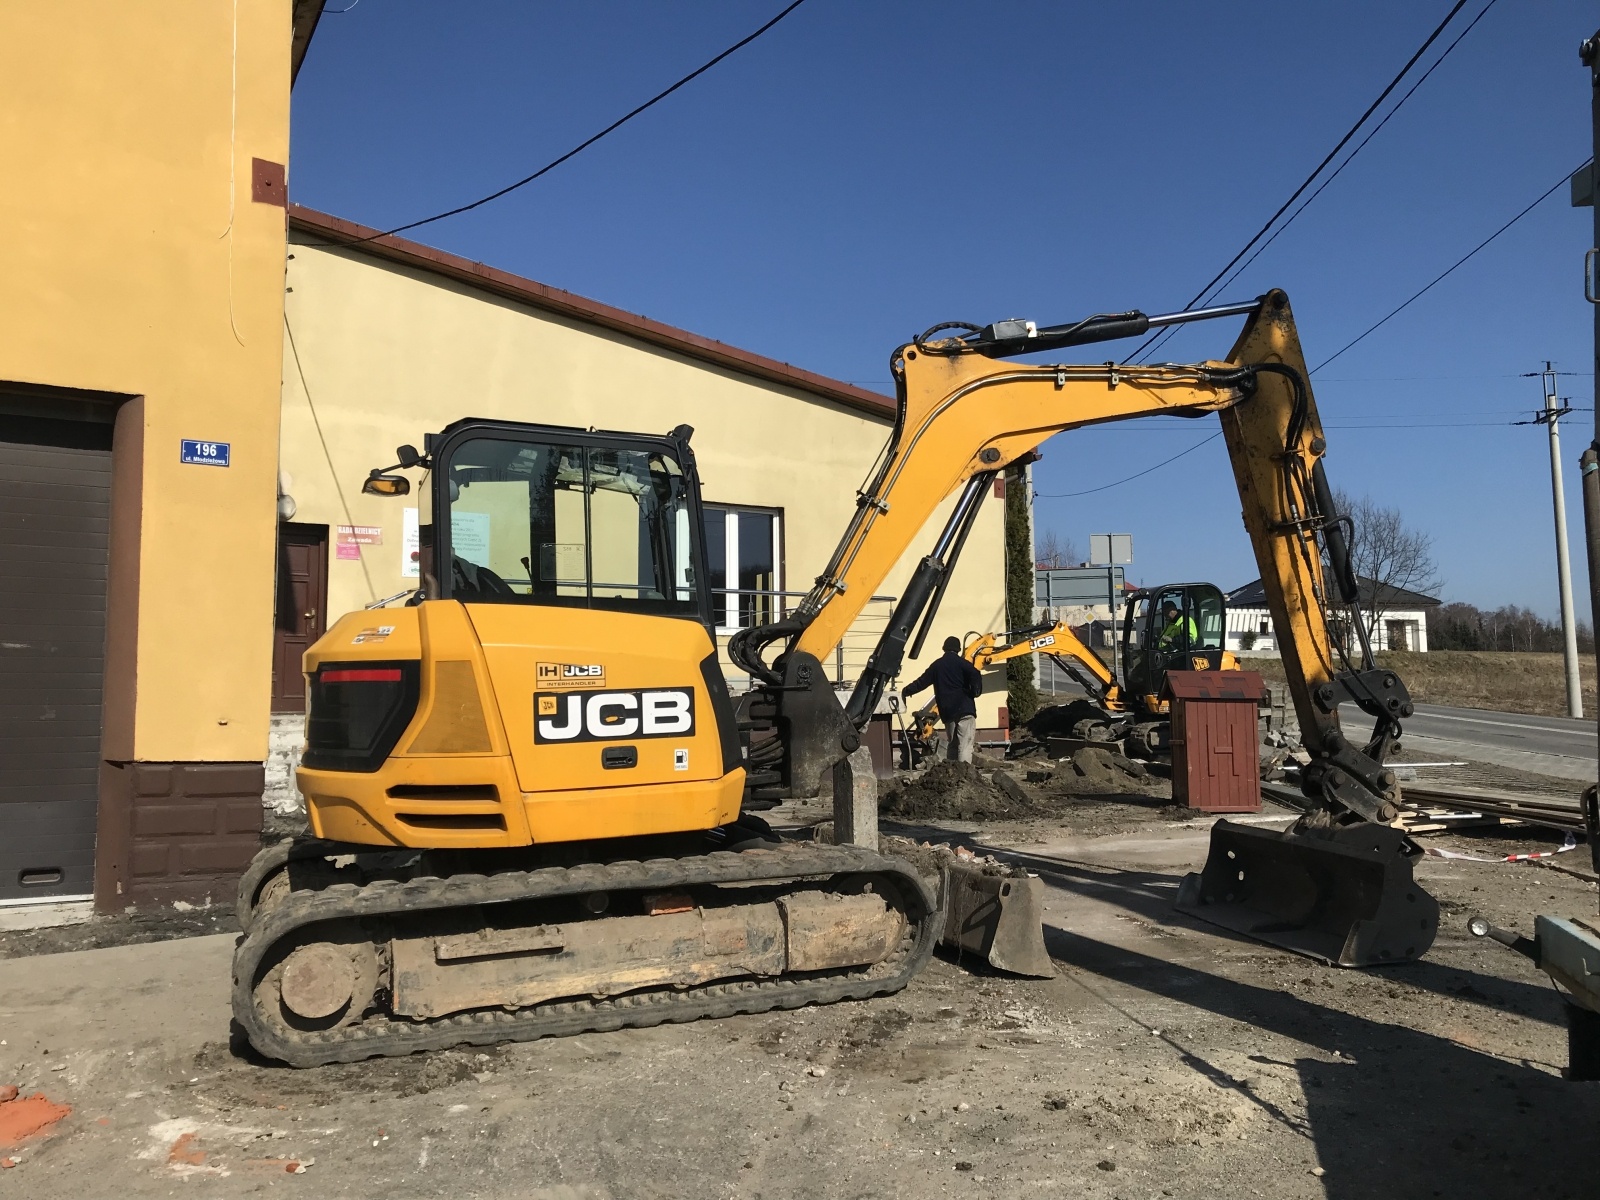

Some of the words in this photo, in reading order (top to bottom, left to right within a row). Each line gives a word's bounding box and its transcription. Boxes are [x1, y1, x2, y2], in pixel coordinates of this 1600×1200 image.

[195, 443, 217, 457] 196
[1030, 635, 1055, 650] JCB
[539, 665, 558, 677] IH
[564, 664, 602, 677] JCB
[1194, 657, 1210, 670] JCB
[538, 691, 692, 740] JCB
